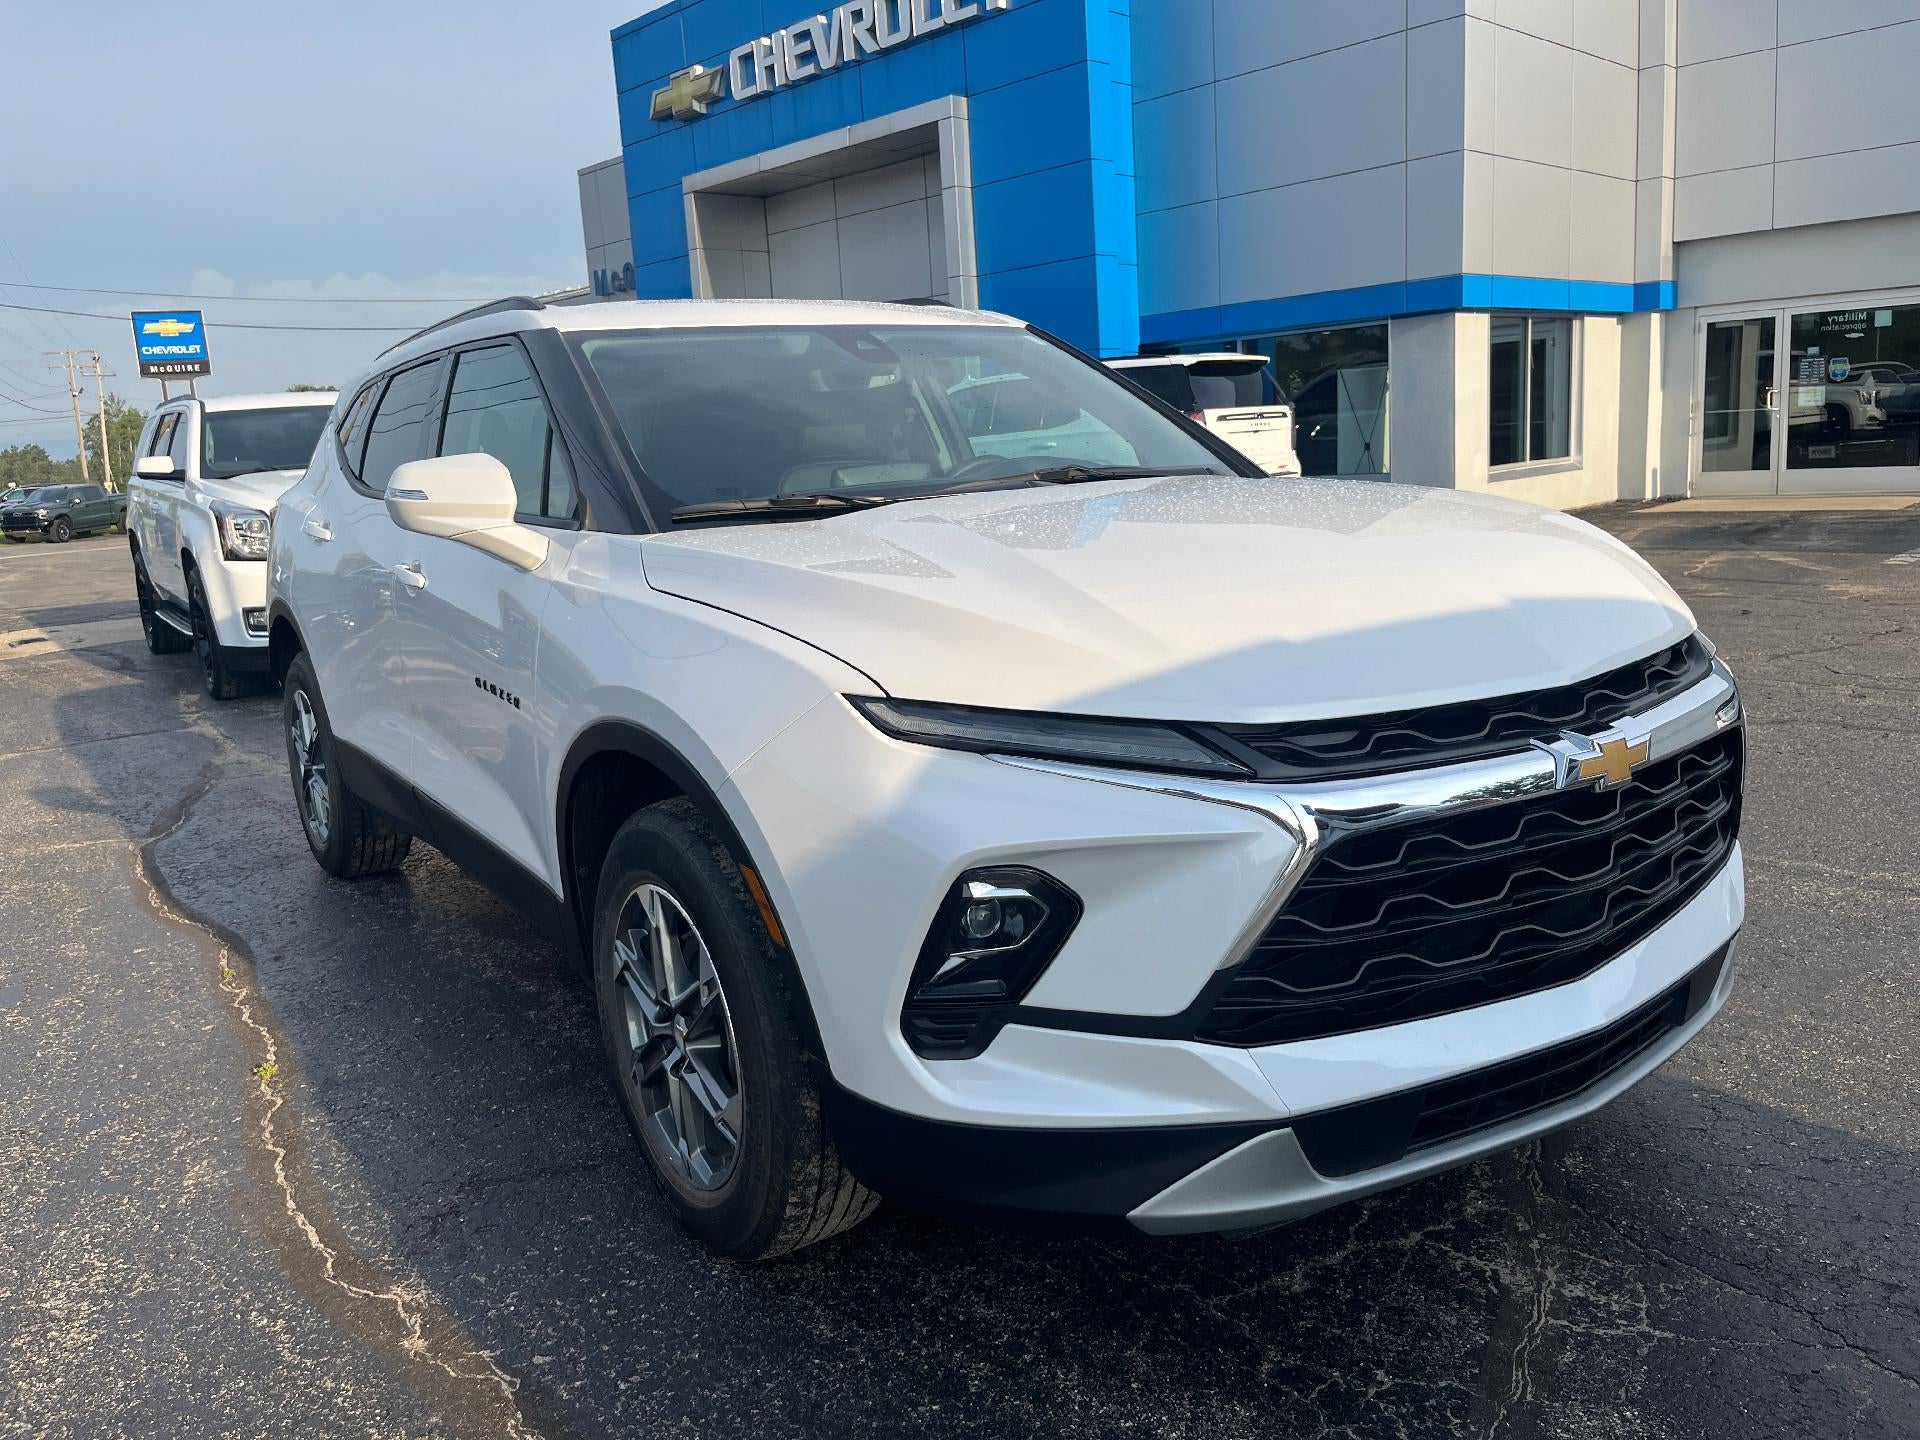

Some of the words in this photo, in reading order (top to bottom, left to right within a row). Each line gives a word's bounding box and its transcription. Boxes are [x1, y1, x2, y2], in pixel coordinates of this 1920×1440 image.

[142, 344, 201, 355] CHEVROLET
[149, 364, 201, 373] McGUIRE
[475, 677, 520, 710] BLAZER
